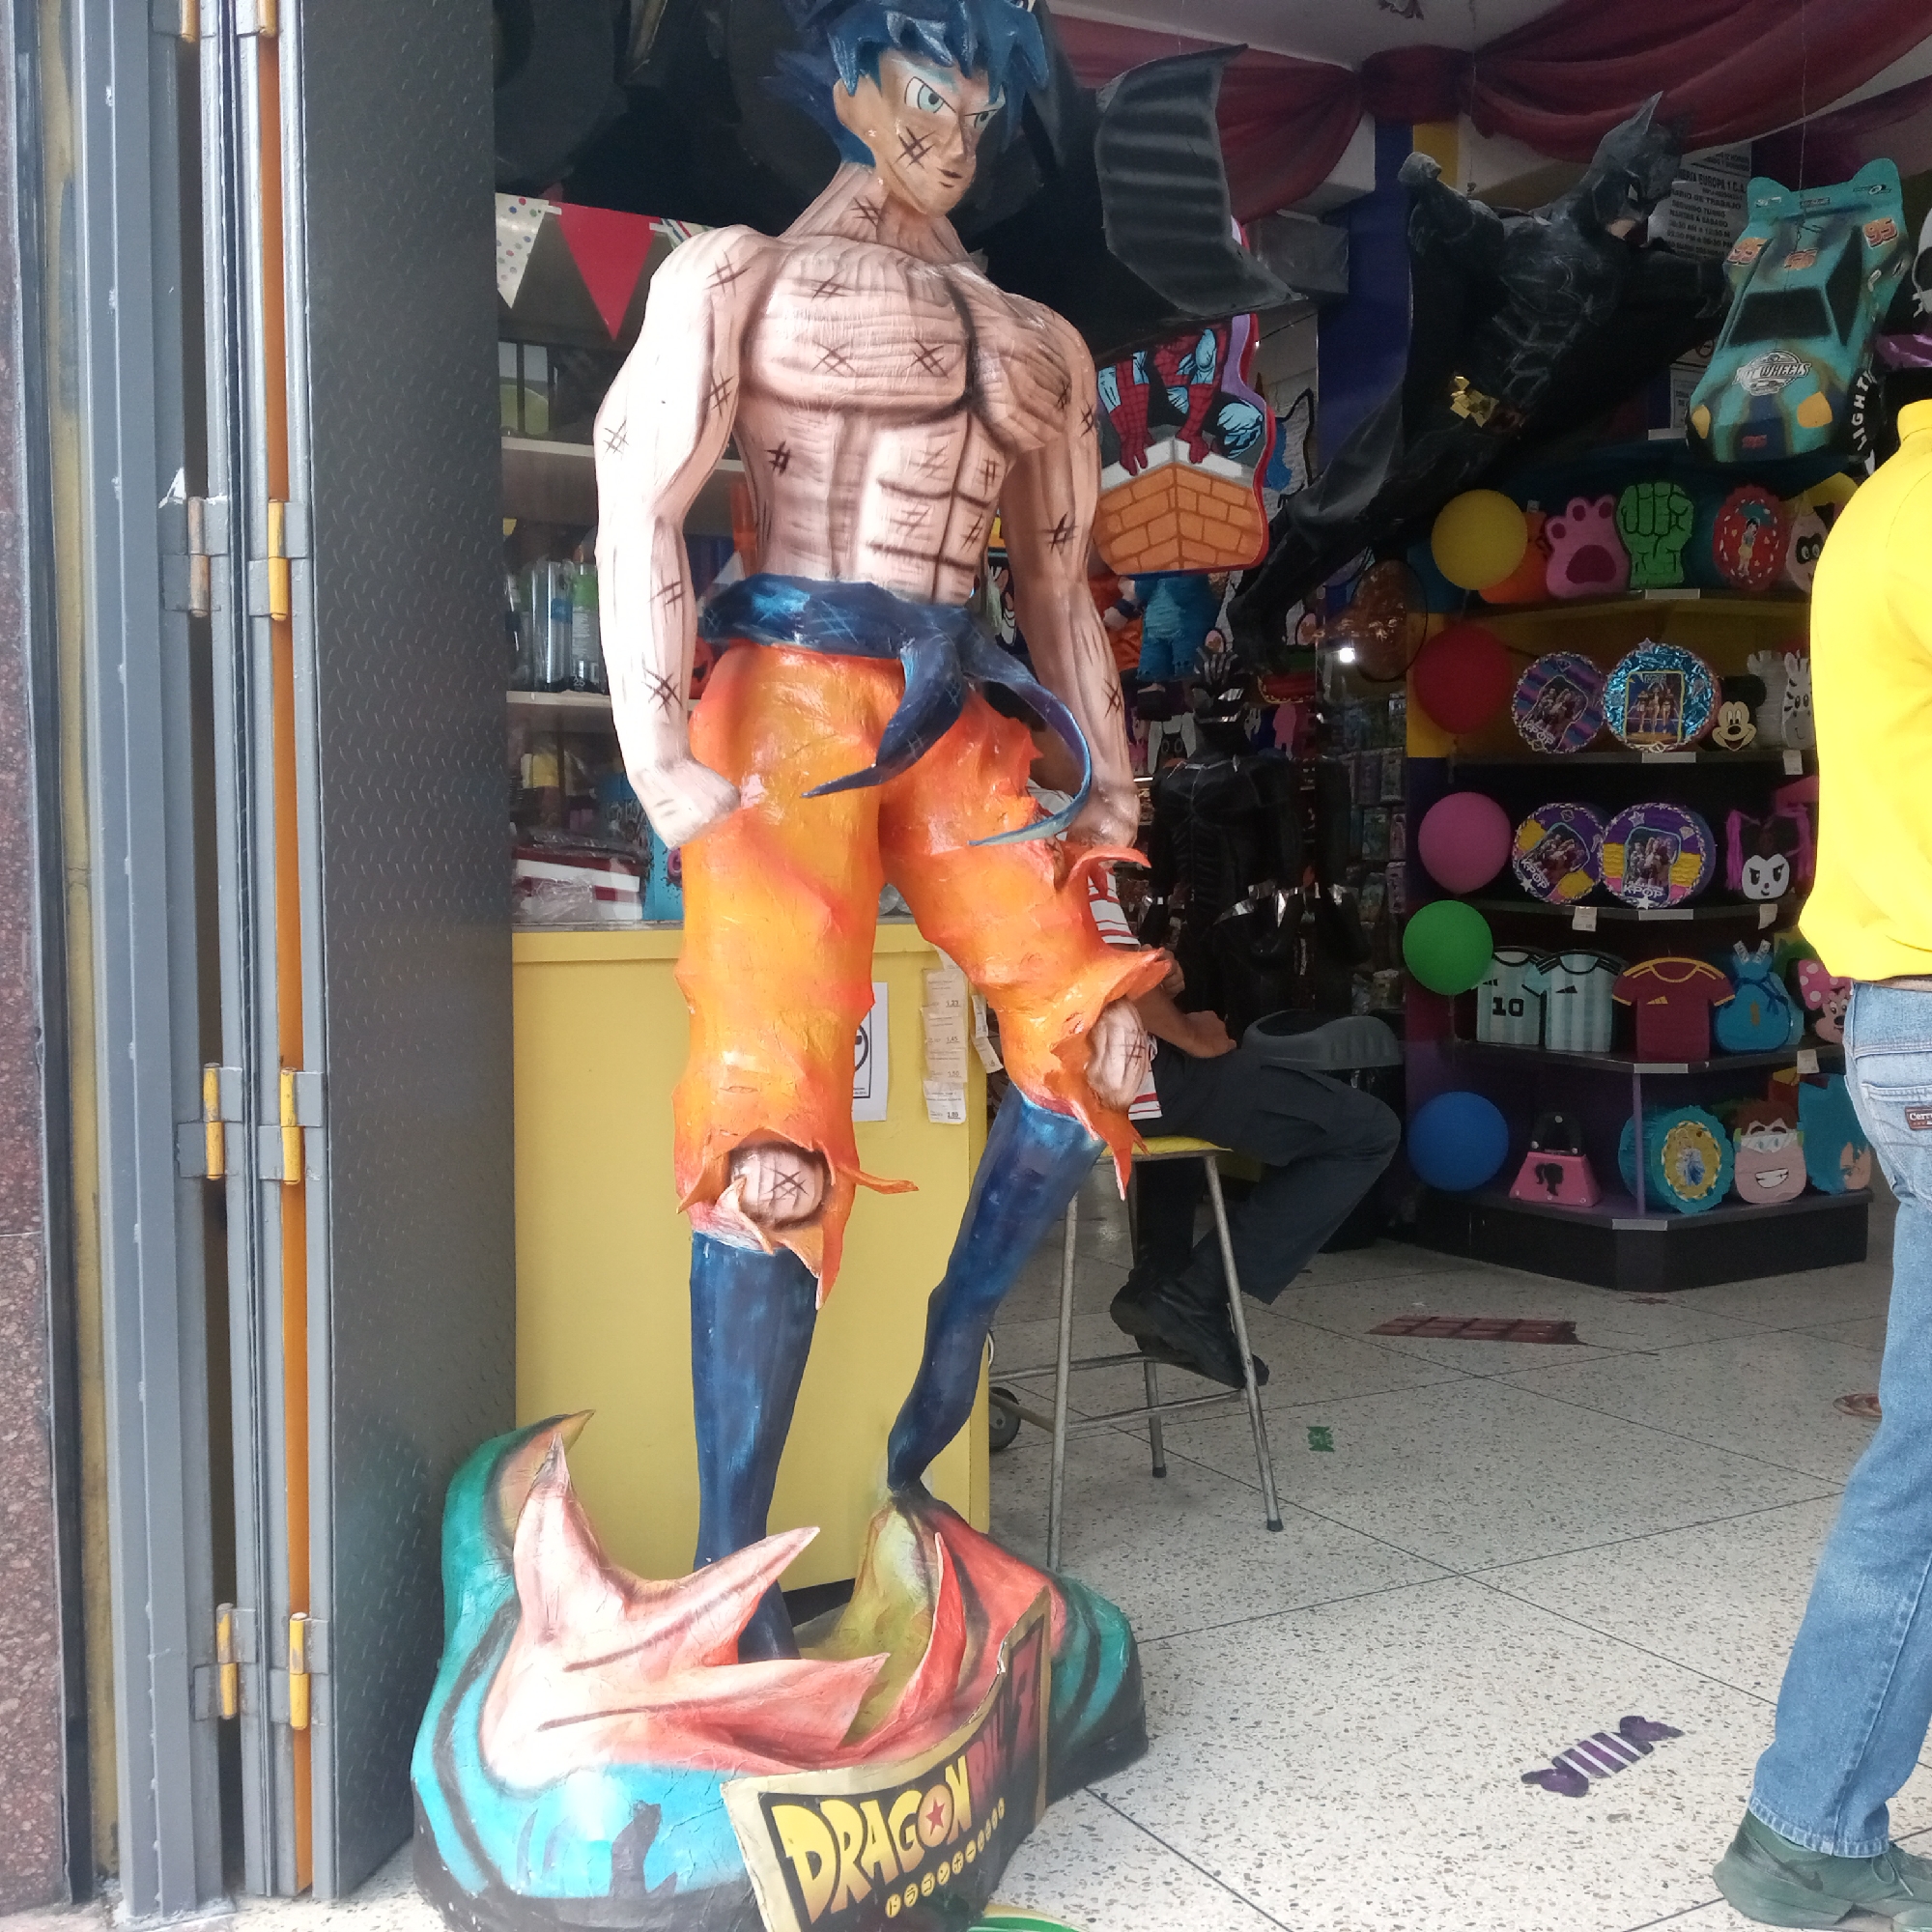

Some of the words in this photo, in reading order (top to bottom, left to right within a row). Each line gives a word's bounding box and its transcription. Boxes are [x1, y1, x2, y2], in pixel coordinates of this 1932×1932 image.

[1698, 173, 1725, 190] EUROPA
[1672, 199, 1702, 213] SEGUNDO
[1703, 207, 1726, 218] TURNO
[1706, 197, 1742, 210] TRABAJO
[1862, 216, 1897, 248] 95
[1758, 361, 1812, 380] WHEELS
[1523, 722, 1556, 746] KPOP
[1520, 859, 1550, 890] KPOP
[1623, 884, 1663, 898] KPOP
[1492, 997, 1524, 1017] 10
[1909, 1111, 1932, 1122] Cerr
[771, 1754, 972, 1924] DRAGON
